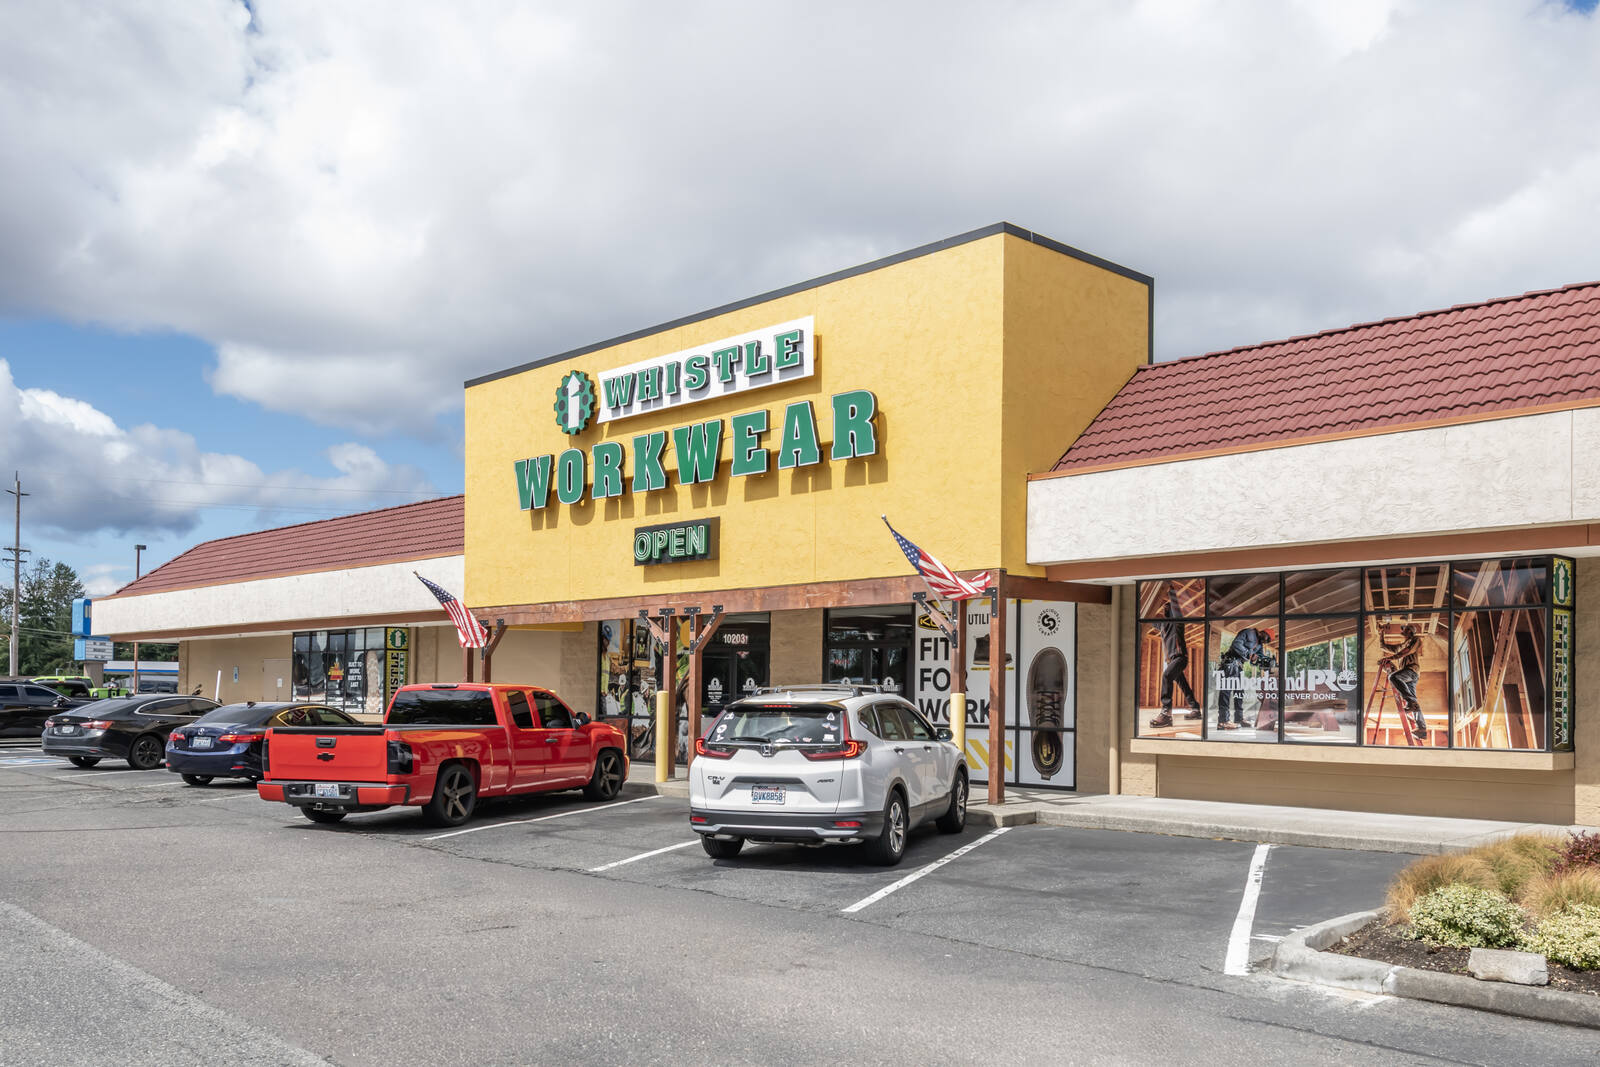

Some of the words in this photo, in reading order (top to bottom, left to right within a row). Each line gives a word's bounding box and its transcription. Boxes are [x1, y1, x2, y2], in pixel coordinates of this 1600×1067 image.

[603, 328, 804, 409] WHISTLE
[514, 389, 879, 511] WORKWEAR
[633, 525, 709, 561] OPEN
[919, 636, 950, 661] FIT
[919, 667, 969, 692] FO
[1211, 669, 1307, 691] Timberland
[1553, 614, 1563, 747] WHISTLE
[1284, 692, 1311, 700] NEVER
